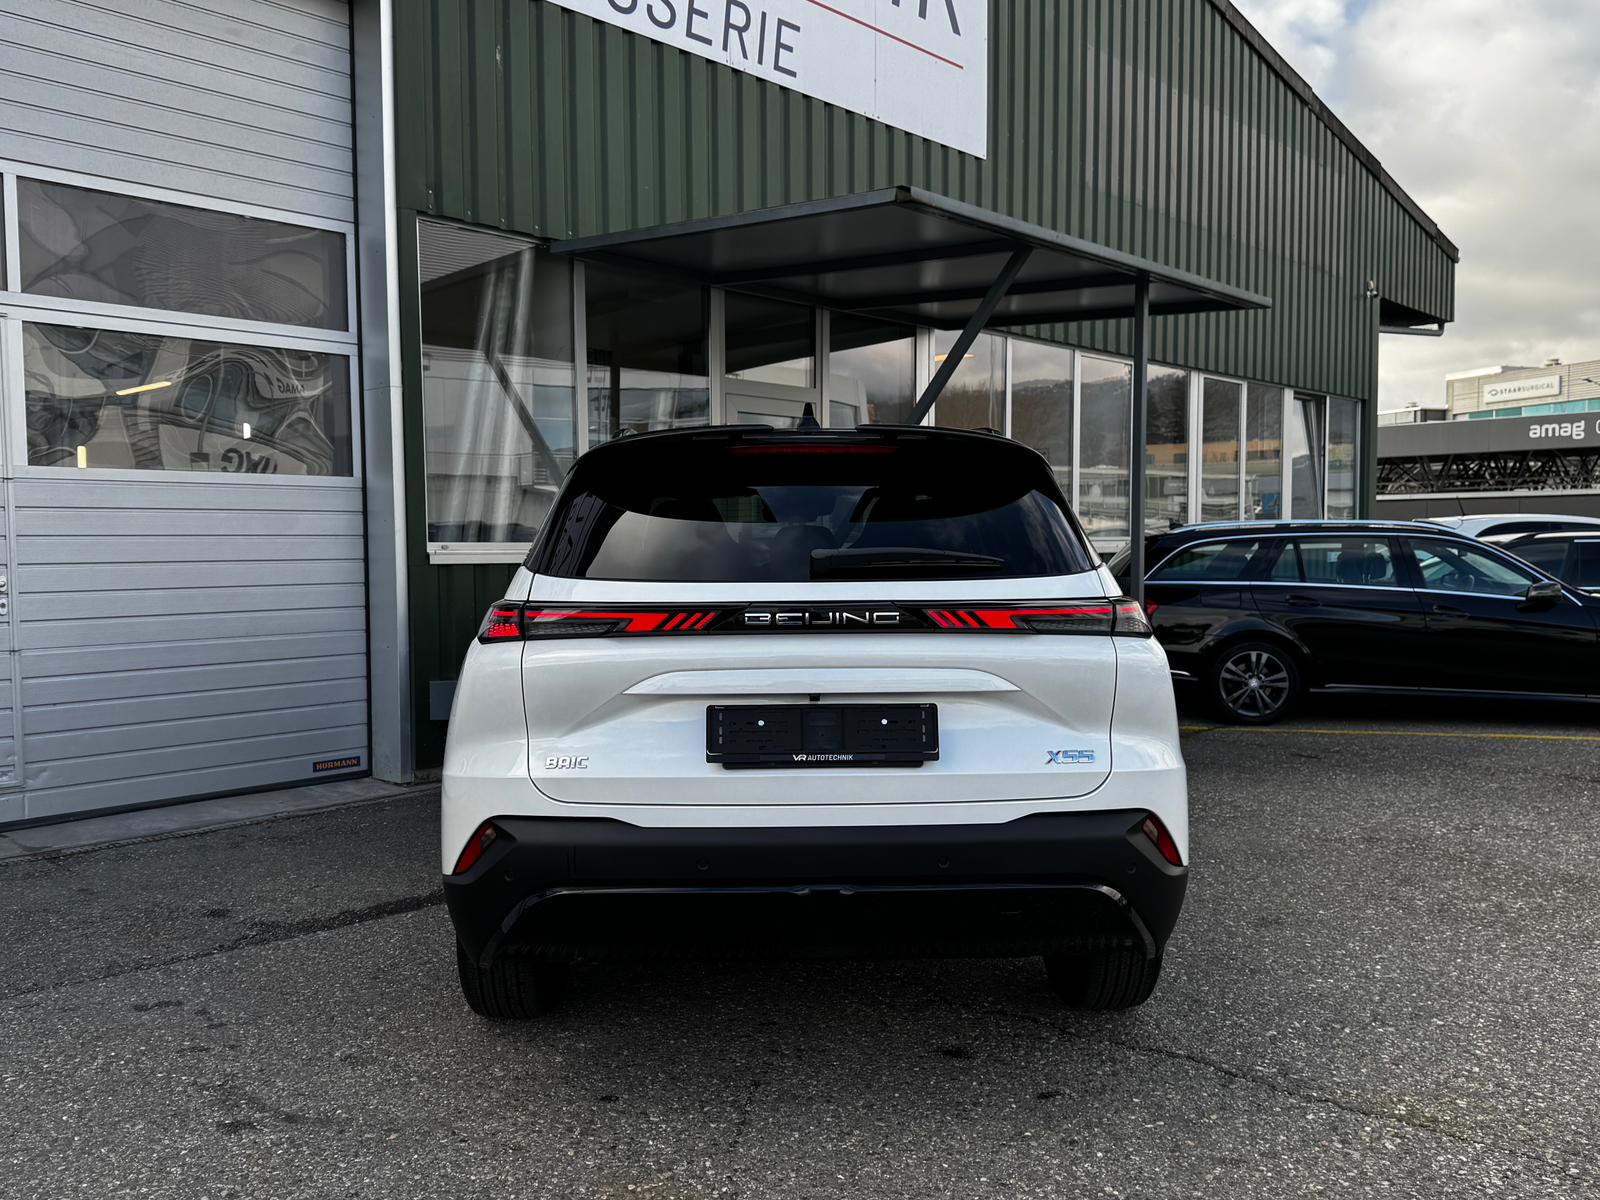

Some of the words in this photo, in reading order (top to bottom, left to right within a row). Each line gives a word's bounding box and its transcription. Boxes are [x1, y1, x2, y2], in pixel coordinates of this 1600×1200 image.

[607, 0, 800, 78] SERIE
[1529, 420, 1585, 440] amag
[744, 612, 900, 625] BEIJING
[545, 756, 590, 770] BAIC
[1045, 750, 1096, 765] X55
